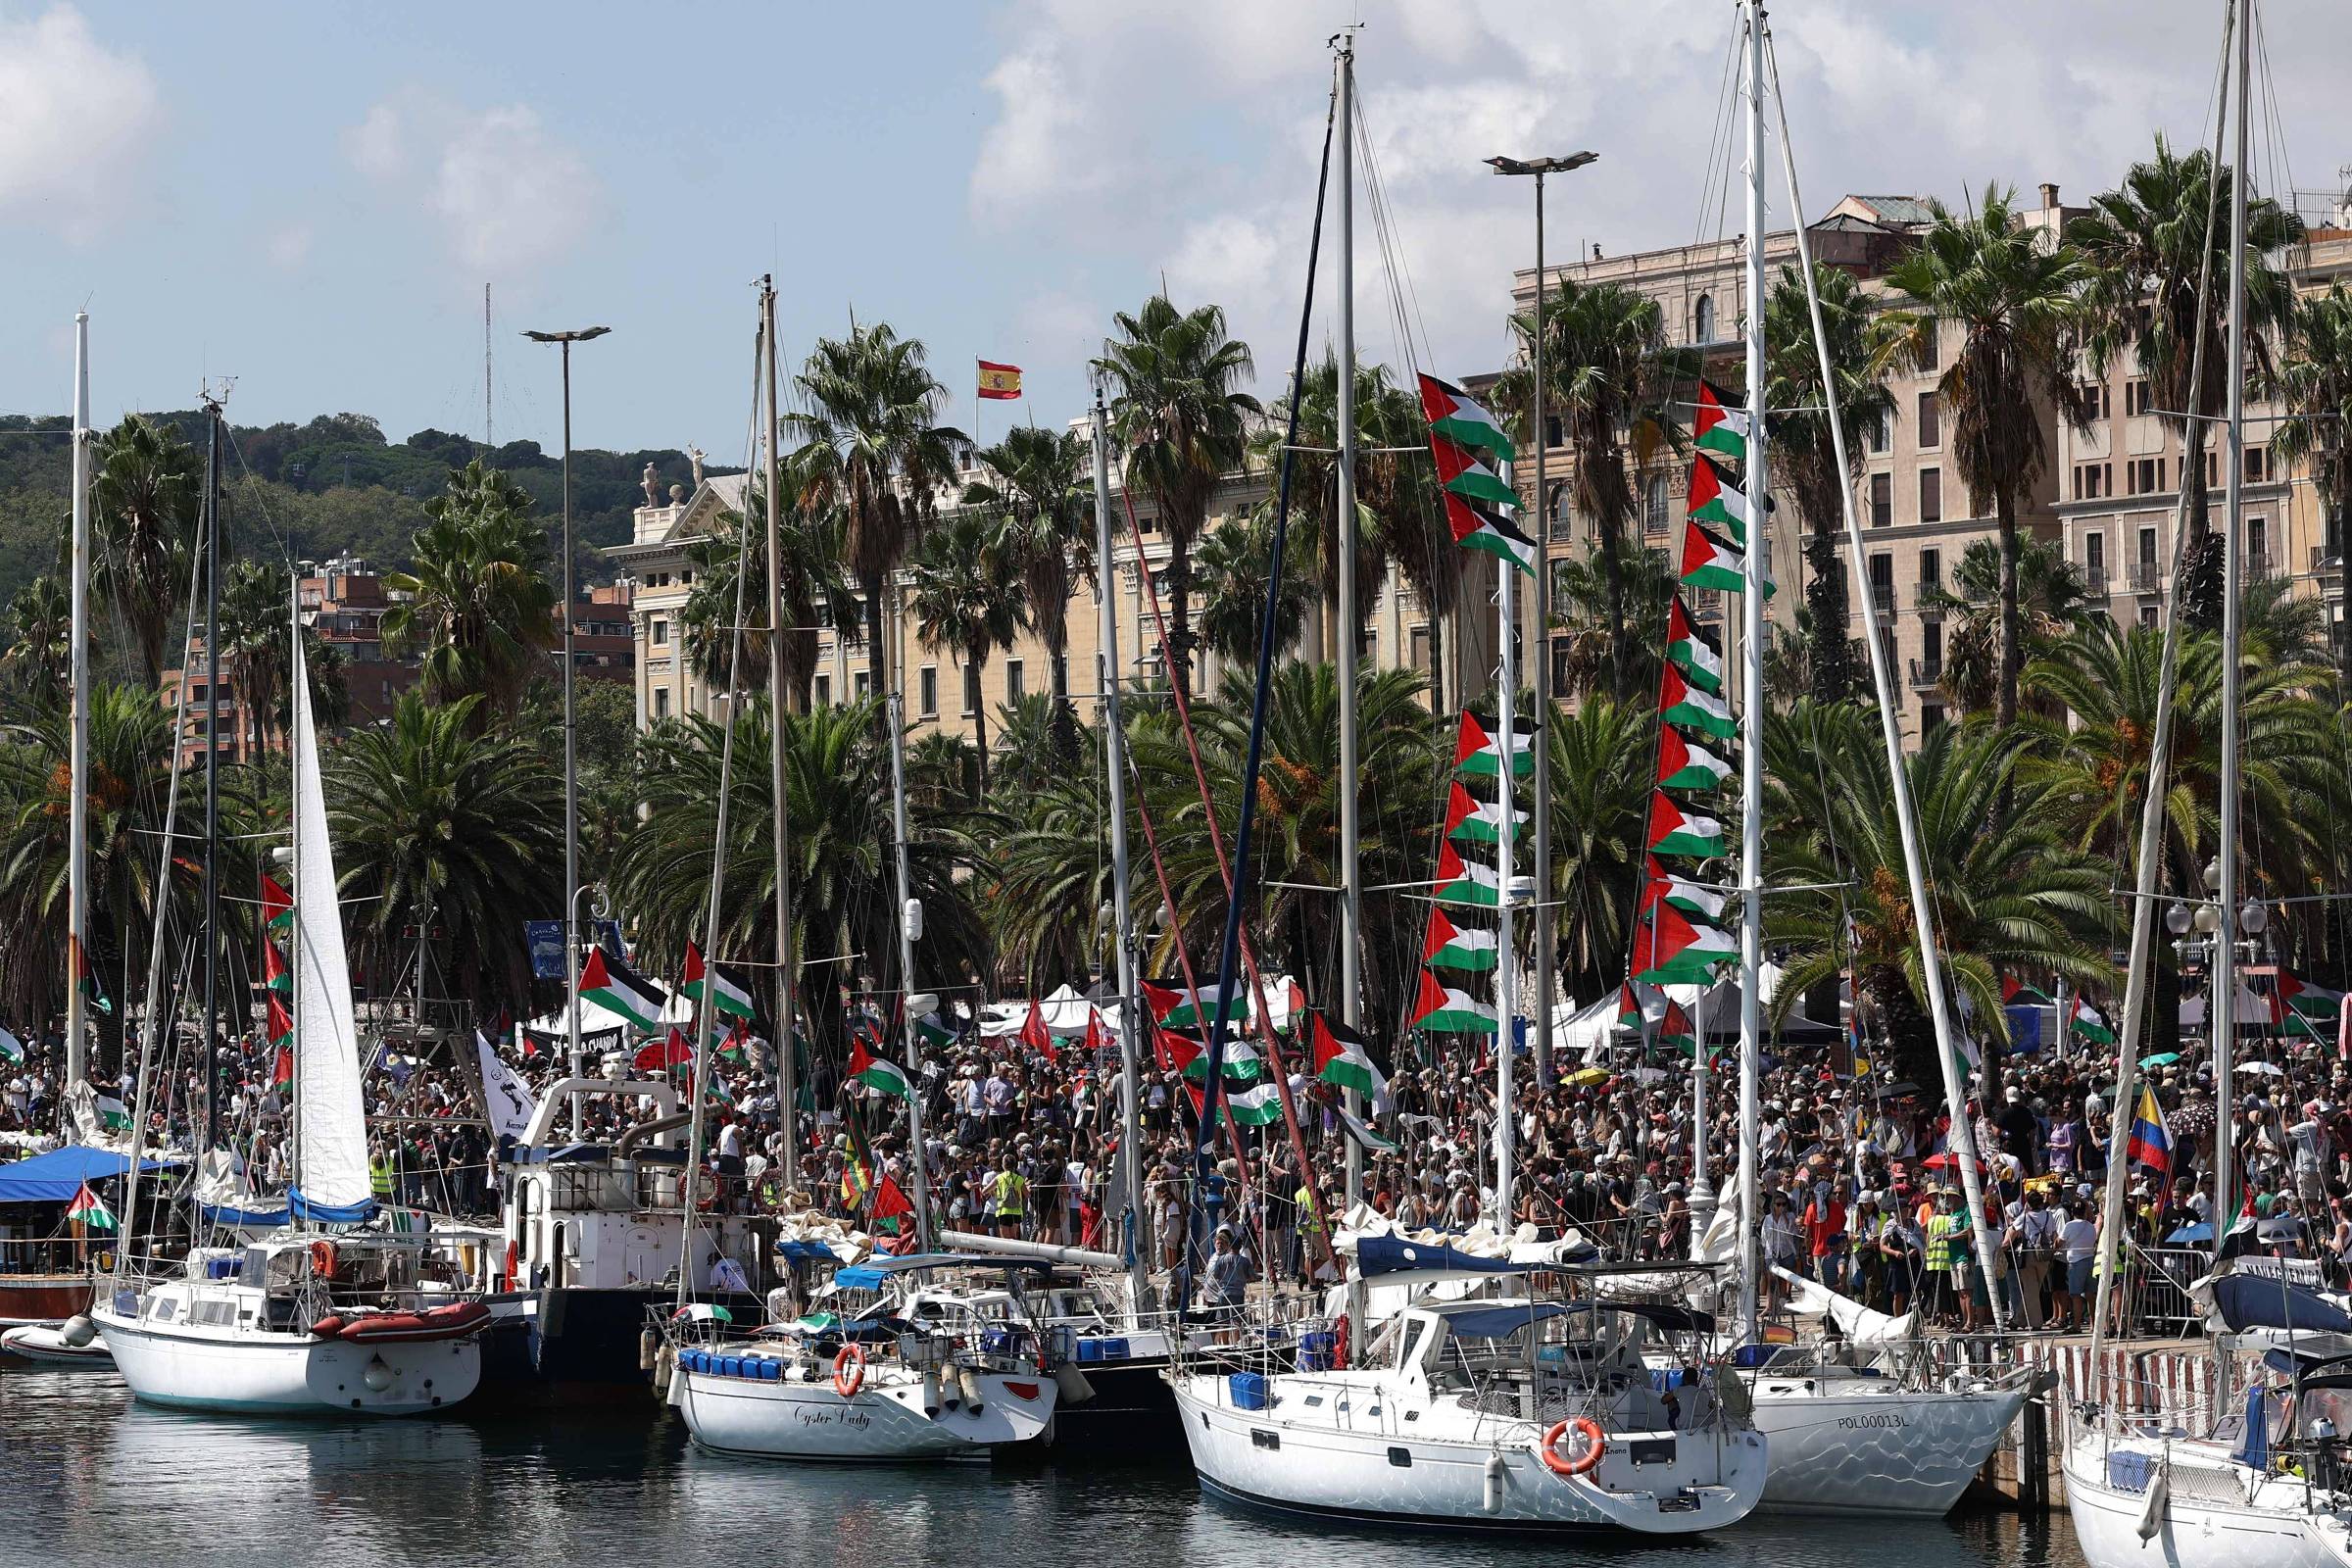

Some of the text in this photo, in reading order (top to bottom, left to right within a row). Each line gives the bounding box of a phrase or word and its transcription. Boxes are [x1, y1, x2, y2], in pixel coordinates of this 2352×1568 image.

[794, 1405, 870, 1431] Oyster Lady
[1838, 1414, 1910, 1430] POL00013L
